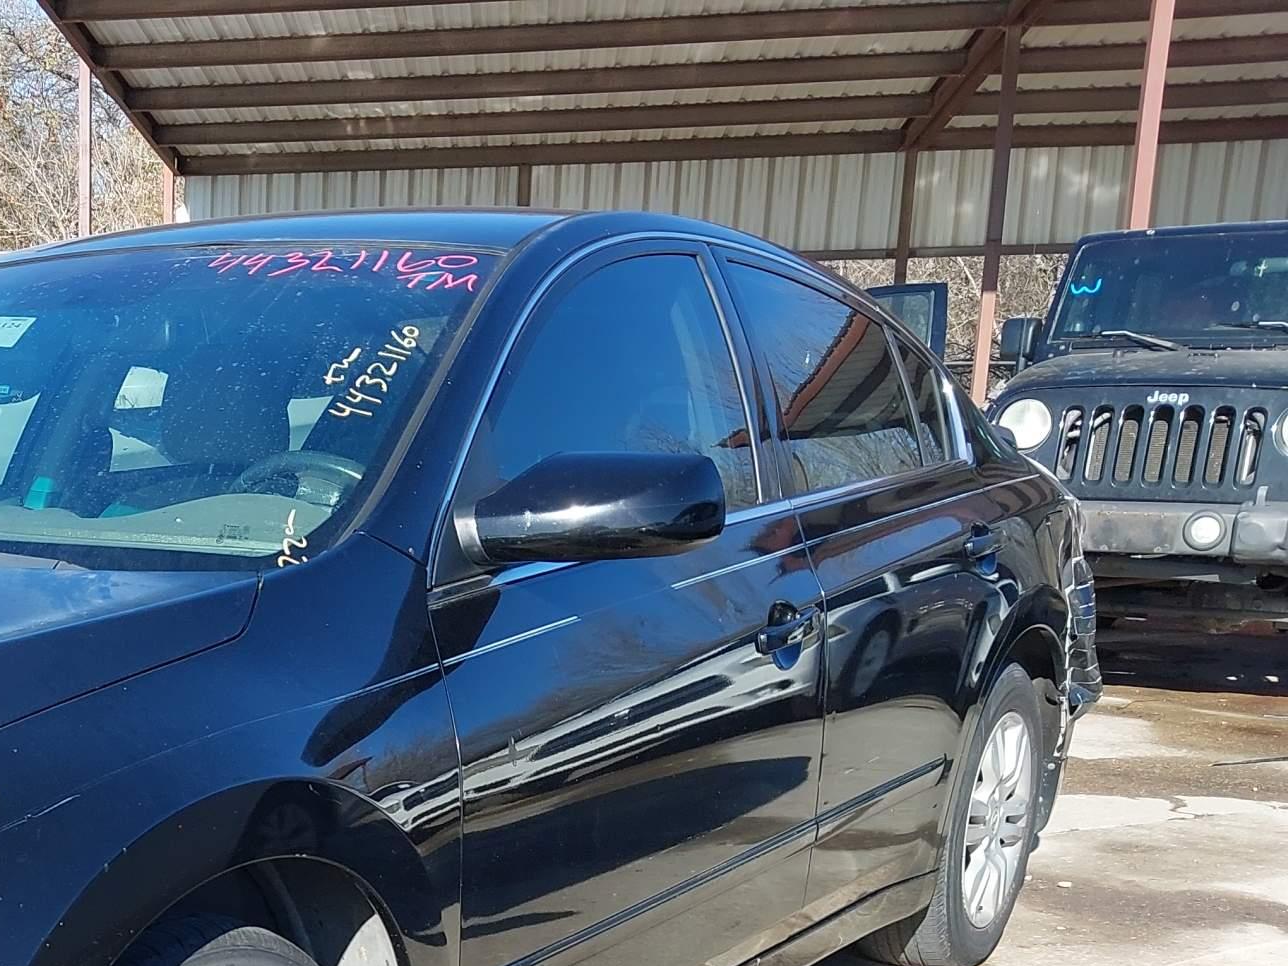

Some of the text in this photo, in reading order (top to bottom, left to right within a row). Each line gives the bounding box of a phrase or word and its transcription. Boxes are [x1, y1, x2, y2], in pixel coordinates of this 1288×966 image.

[207, 250, 479, 277] 44321160
[397, 270, 480, 292] TM
[328, 326, 420, 417] 44321160
[1146, 390, 1190, 407] Jeep
